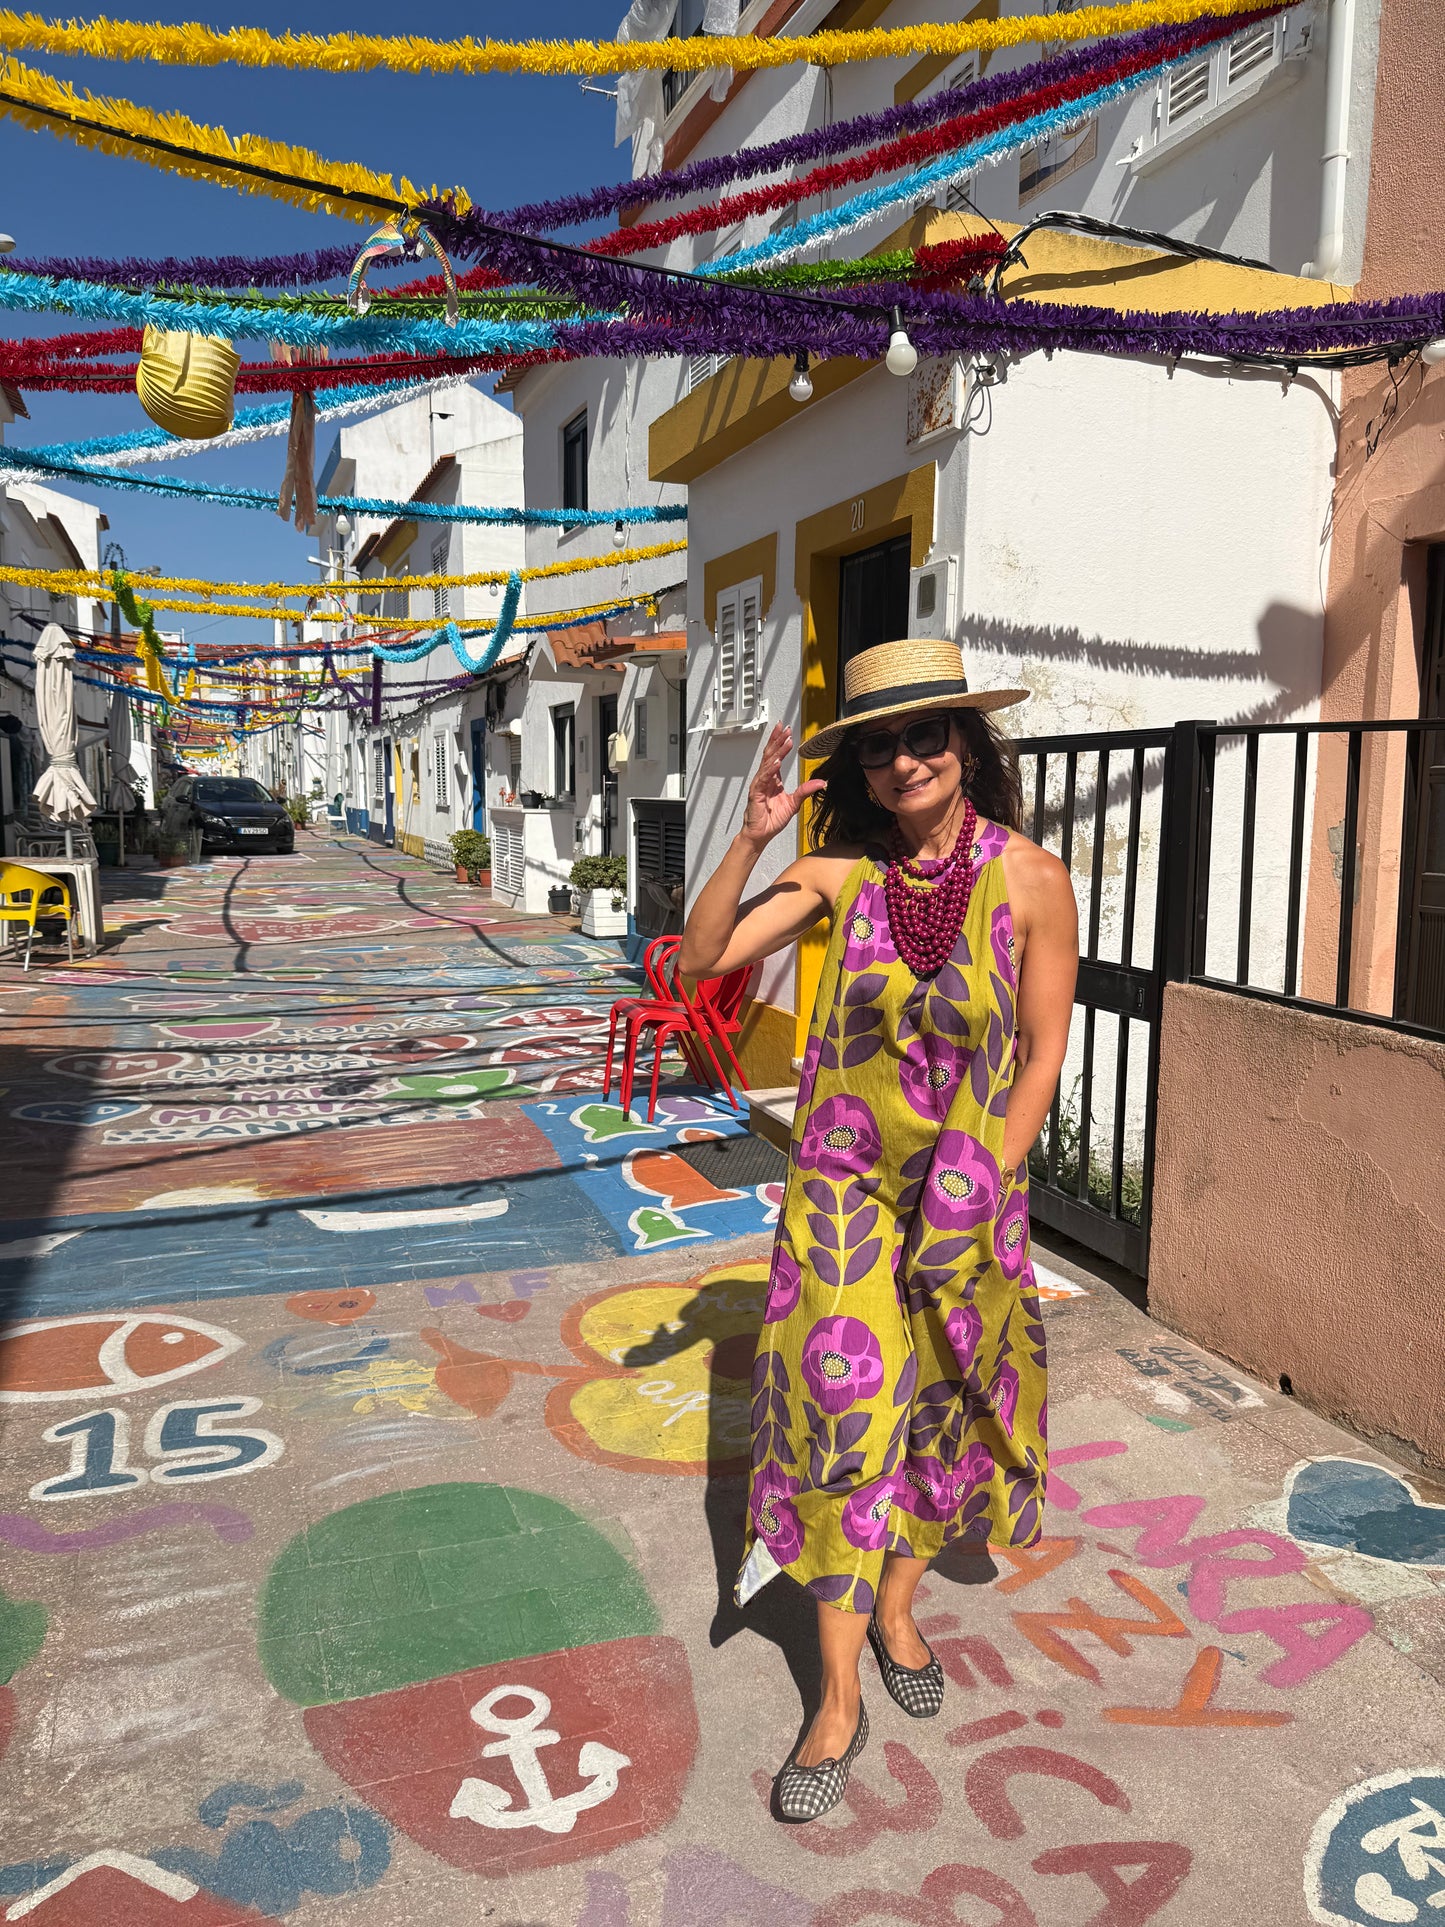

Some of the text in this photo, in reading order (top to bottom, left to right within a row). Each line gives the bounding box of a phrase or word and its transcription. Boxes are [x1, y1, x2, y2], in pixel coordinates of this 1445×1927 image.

[850, 498, 866, 533] 20
[277, 1017, 464, 1036] TOMÁS
[159, 1032, 397, 1052] FRANCISCO
[203, 1049, 340, 1067] DINIS
[151, 1098, 387, 1127] MARTA
[28, 1395, 287, 1502] 15
